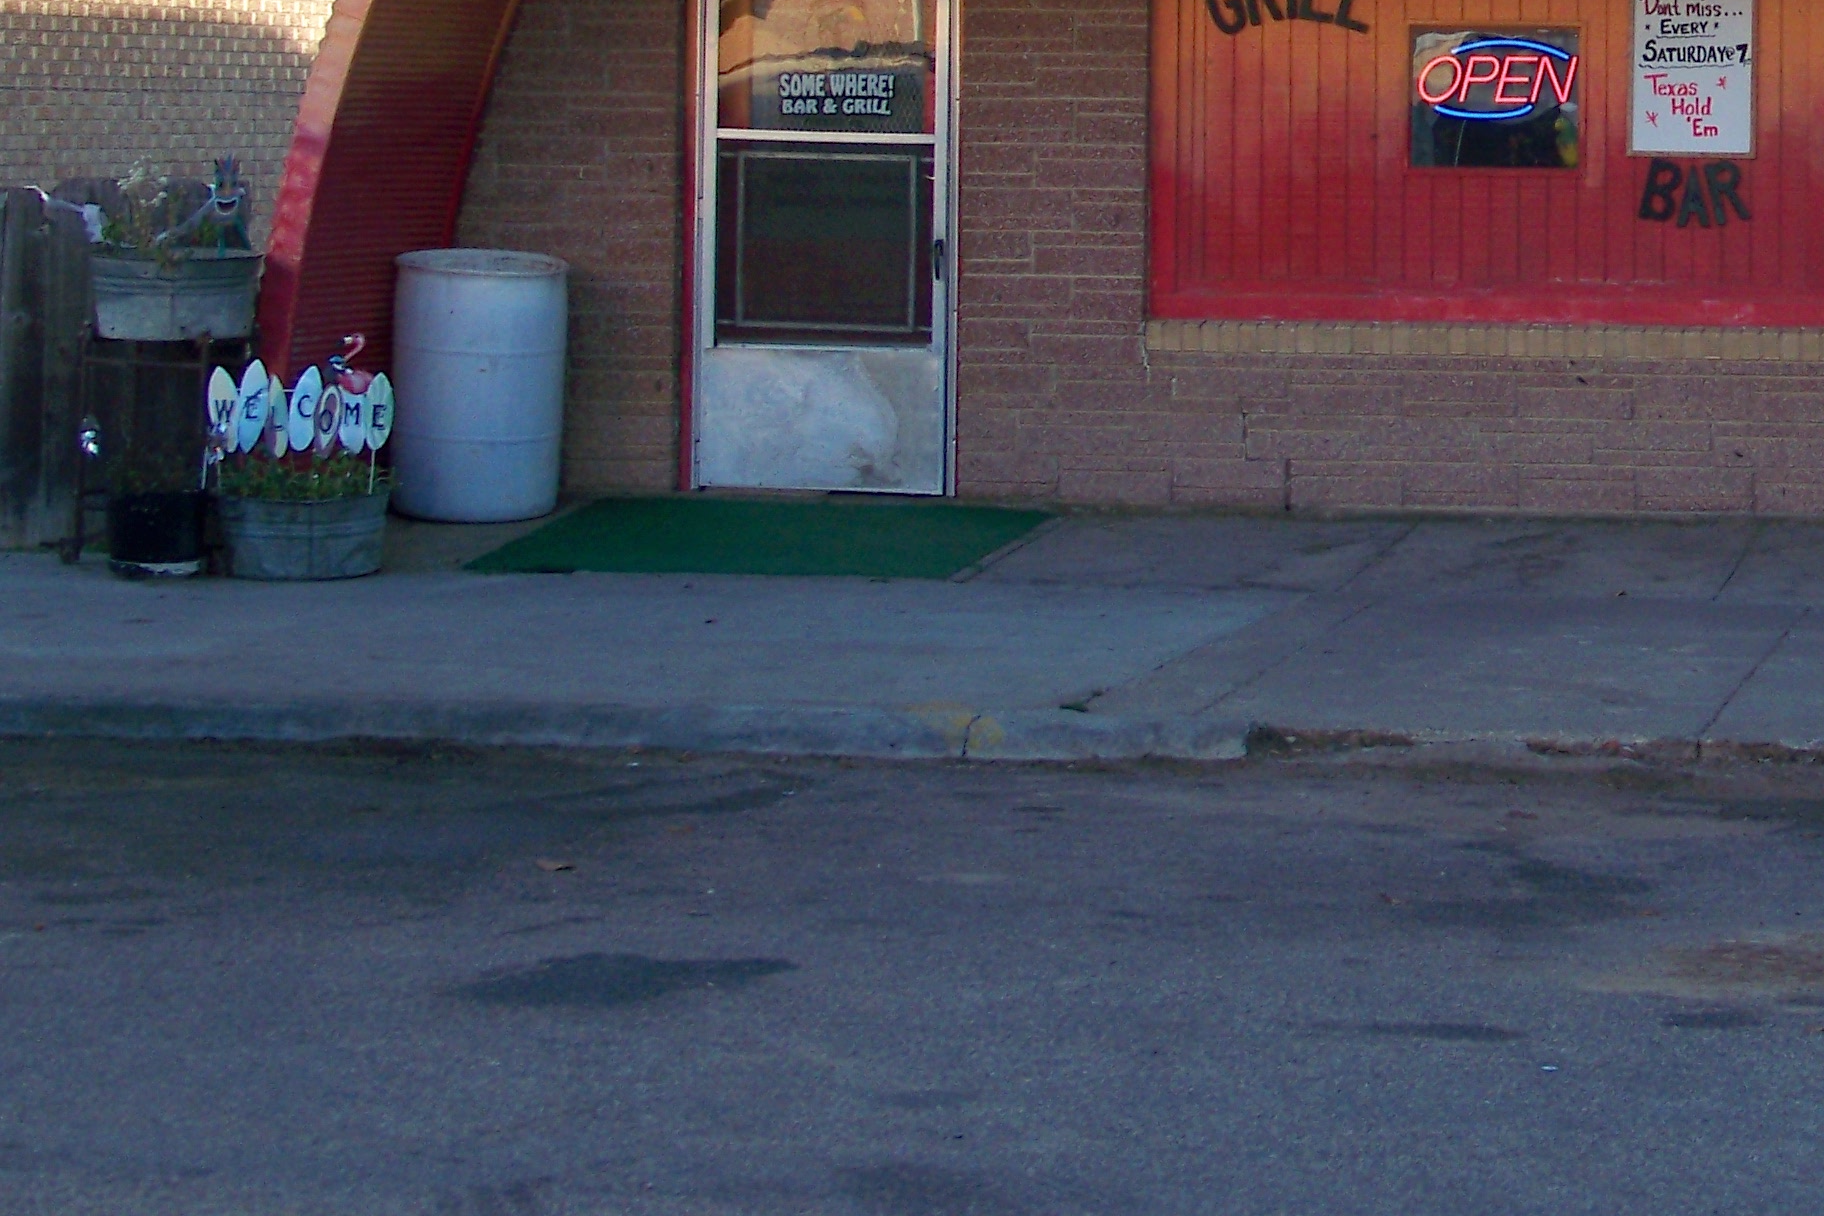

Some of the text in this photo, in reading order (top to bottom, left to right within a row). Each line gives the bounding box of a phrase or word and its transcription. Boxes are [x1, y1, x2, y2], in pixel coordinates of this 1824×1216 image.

[1660, 18, 1709, 35] EVERY
[779, 73, 826, 98] SOME
[1417, 54, 1579, 105] OPEN
[1643, 73, 1698, 96] Texas
[782, 98, 892, 116] BAR & GRILL
[1671, 96, 1713, 116] Hold
[1639, 158, 1752, 229] BAR
[214, 394, 388, 432] WELCOME
